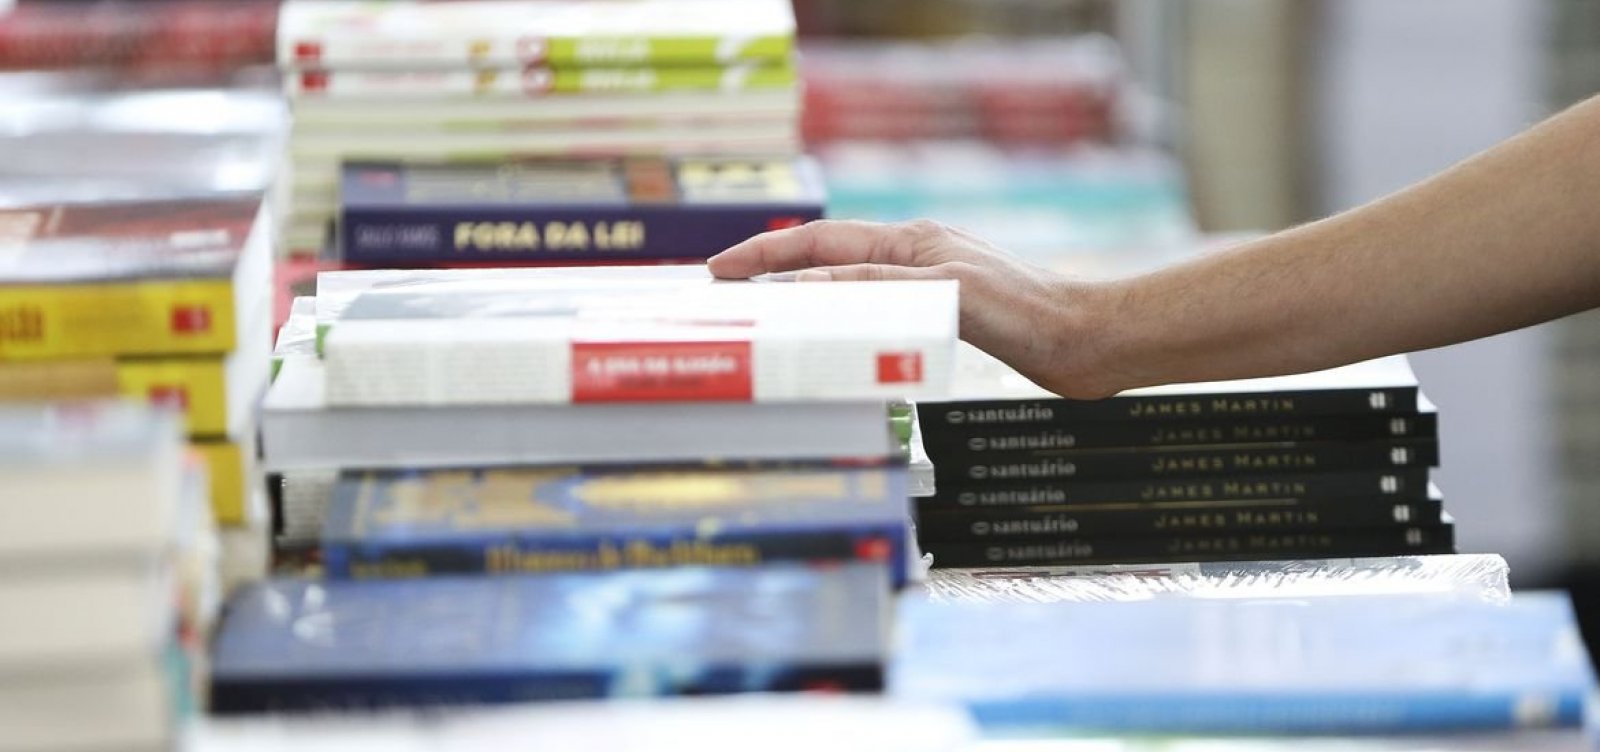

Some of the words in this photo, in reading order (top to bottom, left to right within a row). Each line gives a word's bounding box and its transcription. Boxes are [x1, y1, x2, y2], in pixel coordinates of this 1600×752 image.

[454, 220, 540, 251] FORA
[544, 220, 589, 250] DA
[594, 220, 645, 250] LEI
[967, 404, 1053, 421] santuário
[1129, 403, 1201, 416] JAMES
[1212, 398, 1294, 411] MARTIN
[989, 431, 1075, 449] santuário
[990, 460, 1076, 477] santuário
[1152, 457, 1223, 471] JAMES
[1235, 453, 1315, 467] MARTIN
[980, 488, 1065, 504] santuário
[1141, 484, 1212, 498] JAMES
[1224, 481, 1305, 494] MARTIN
[992, 516, 1078, 533] santuário
[1155, 512, 1226, 527] JAMES
[1237, 510, 1318, 523] MARTIN
